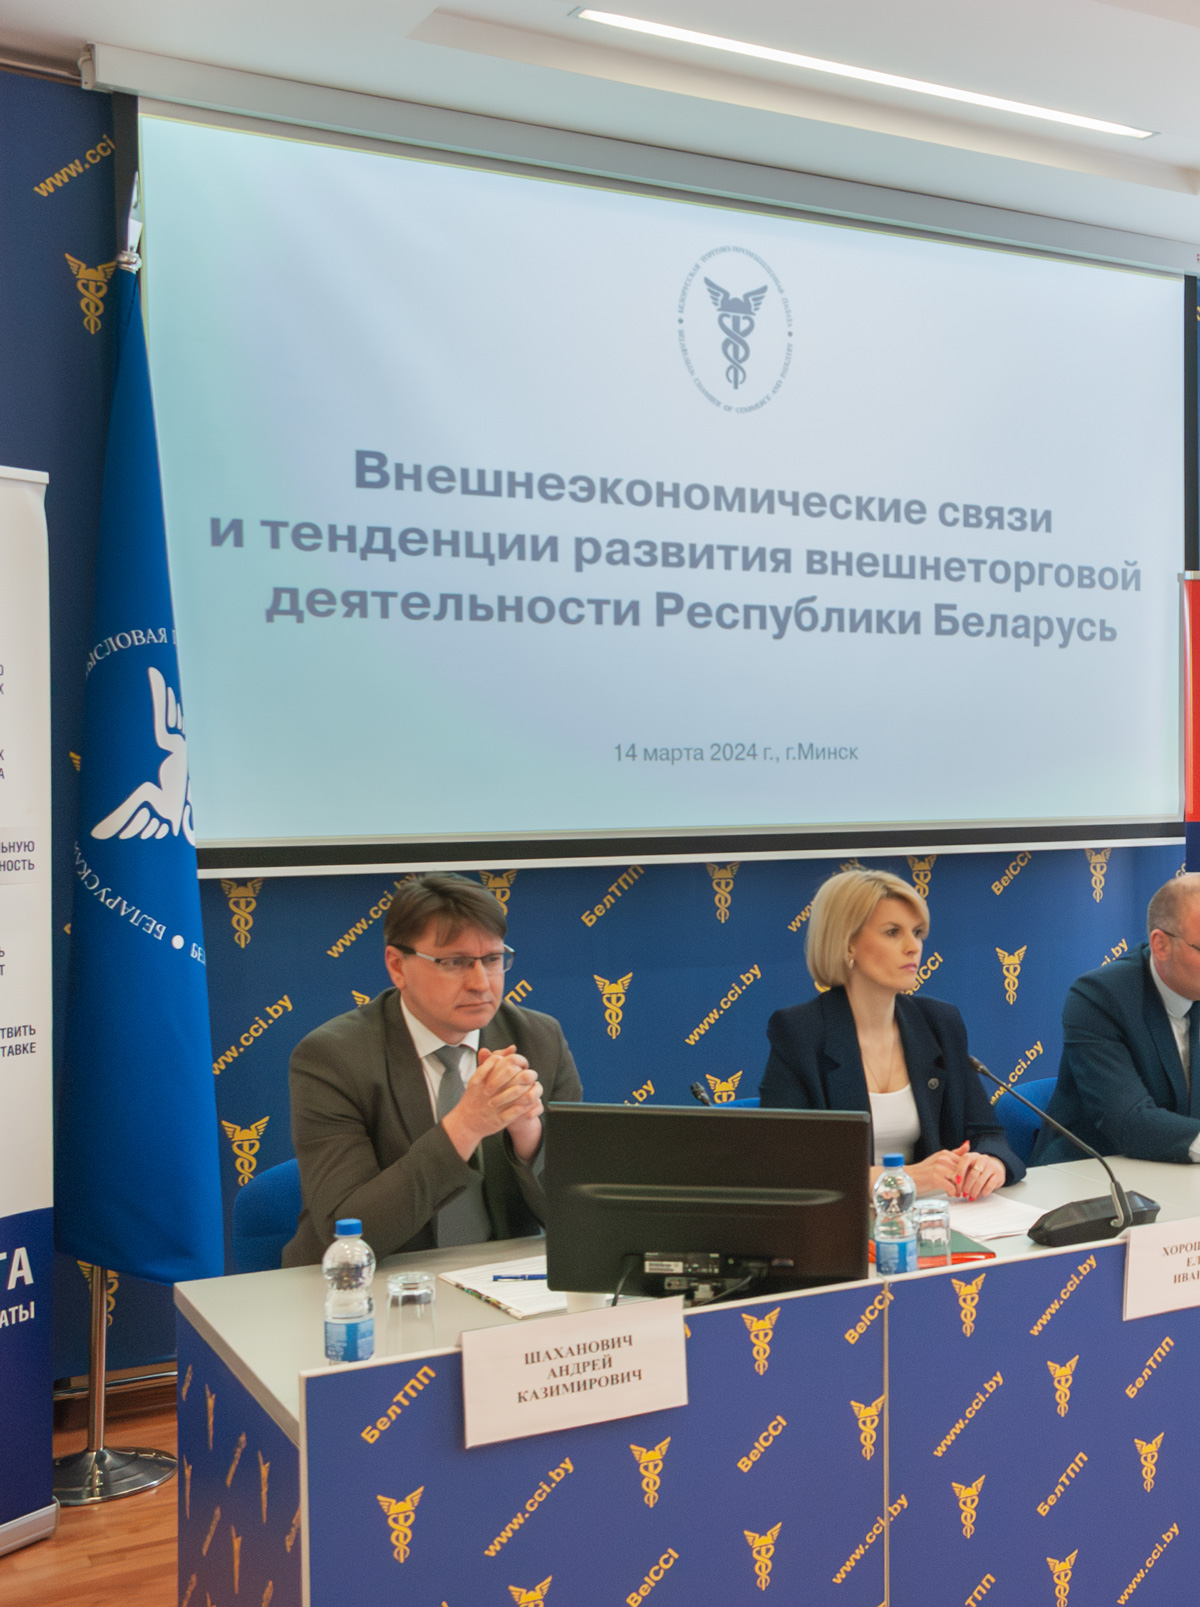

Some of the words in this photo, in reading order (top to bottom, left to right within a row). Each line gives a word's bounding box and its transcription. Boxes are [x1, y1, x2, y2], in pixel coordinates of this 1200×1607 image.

[354, 449, 927, 525] Внешнеэкономические
[938, 502, 1053, 534] связи
[209, 517, 244, 548] и
[260, 518, 559, 565] тенденции
[573, 533, 792, 574] развития
[805, 550, 1142, 593] внешнеторговой
[265, 585, 640, 627] деятельности
[655, 591, 922, 640] Республики
[933, 602, 1118, 649] Беларусь
[614, 744, 637, 762] 14
[643, 748, 704, 766] марта
[710, 743, 757, 762] 2024
[763, 748, 780, 764] г.,
[785, 743, 859, 762] г.Минск
[580, 864, 645, 928] БелТПП
[991, 850, 1032, 896] BelCCI
[684, 963, 763, 1046] www.cci.by
[844, 1289, 895, 1345] BelCCI
[1029, 1254, 1098, 1337] www.cci.by
[523, 1334, 634, 1366] ШАХАНОВИЧ
[546, 1354, 613, 1380] АНДРЕЙ
[1125, 1335, 1175, 1399] БелТПП
[360, 1365, 436, 1445] БелТПП
[516, 1368, 643, 1404] КАЗИМИРОВИЧ
[933, 1370, 1004, 1457] www.cci.by
[736, 1414, 788, 1473] BelCCI
[483, 1456, 574, 1557] www.cci.by
[1036, 1451, 1089, 1517] БелТПП
[625, 1547, 680, 1607] BelCCI
[1116, 1522, 1180, 1606] www.cci.by
